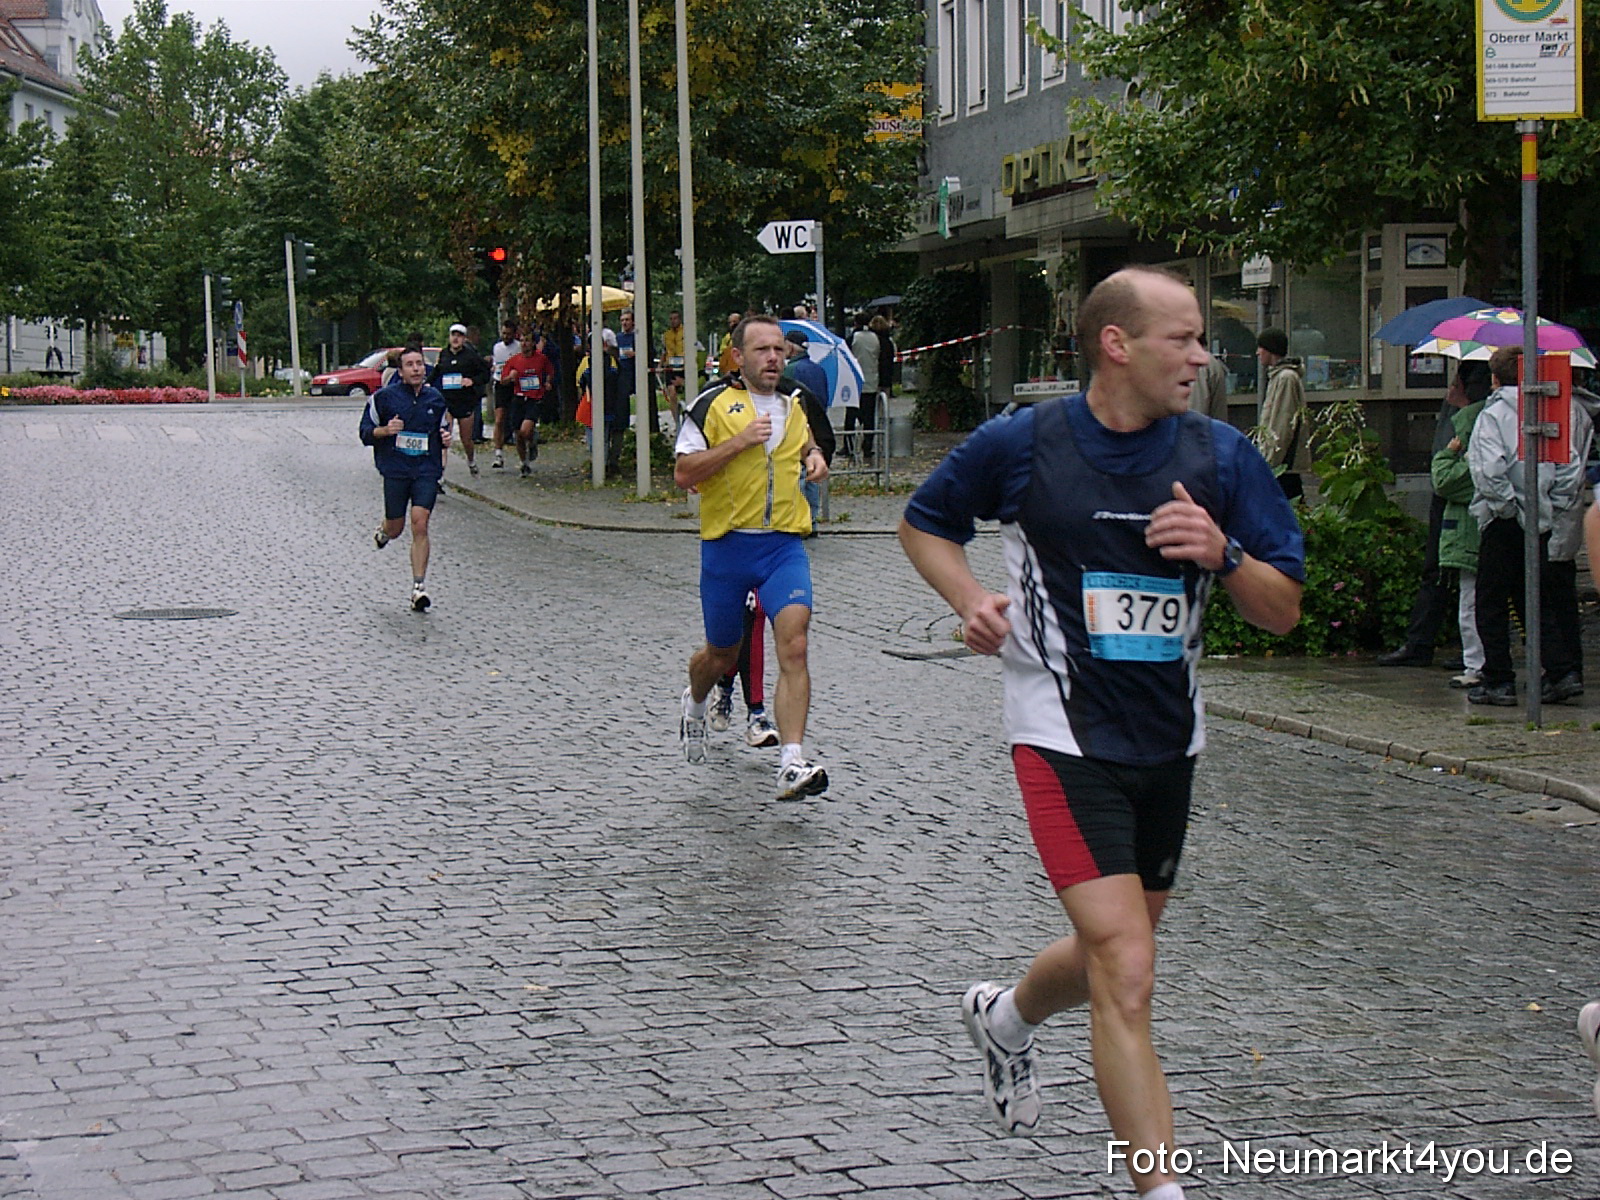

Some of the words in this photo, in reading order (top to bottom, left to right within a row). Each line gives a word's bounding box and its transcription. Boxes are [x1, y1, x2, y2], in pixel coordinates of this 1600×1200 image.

[1489, 33, 1530, 43] Oberer
[1535, 31, 1569, 42] Markt
[774, 225, 808, 249] WC
[1117, 593, 1181, 634] 379
